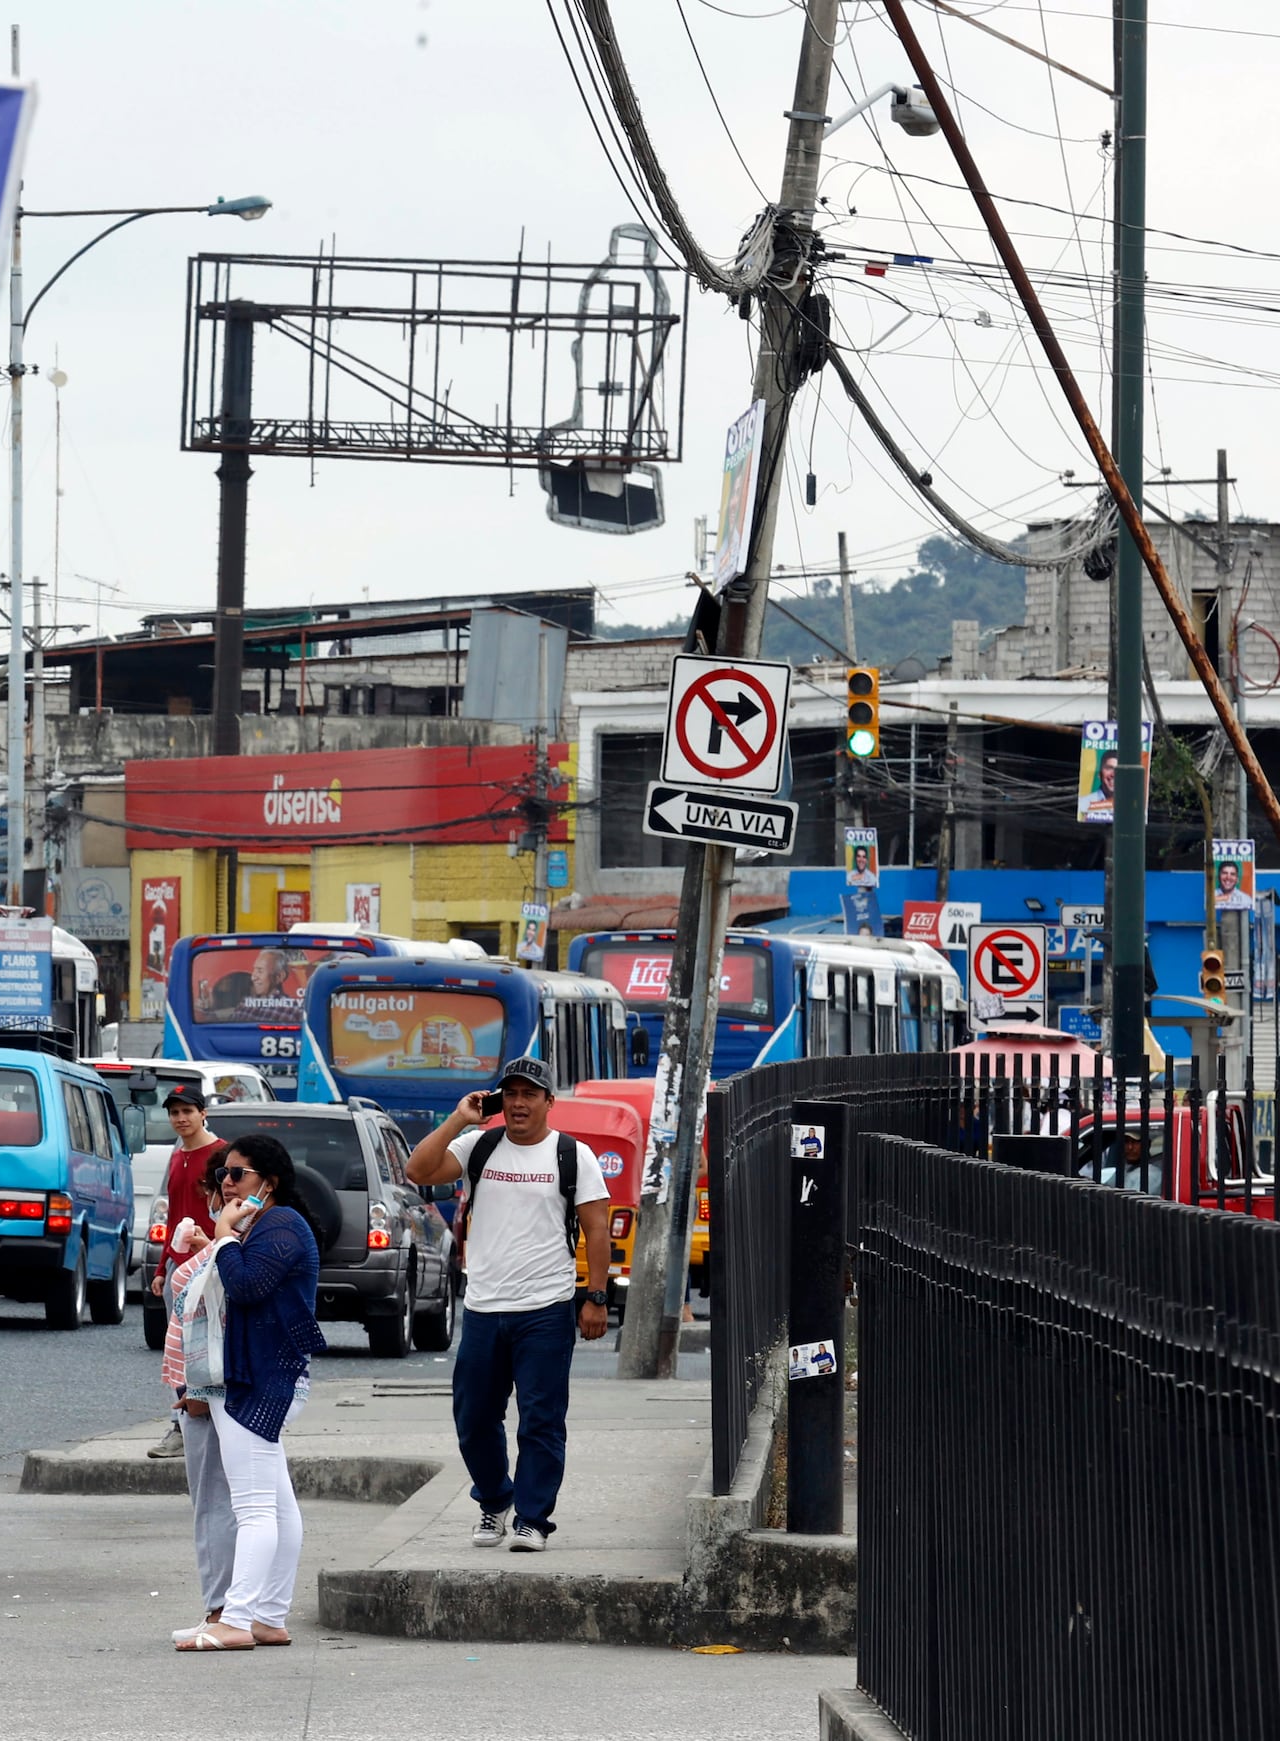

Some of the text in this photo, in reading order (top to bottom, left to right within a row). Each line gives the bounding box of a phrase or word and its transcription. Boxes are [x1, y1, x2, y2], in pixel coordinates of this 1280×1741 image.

[686, 805, 777, 836] UNA VIA
[846, 830, 875, 841] OTTO
[522, 904, 548, 917] OTTO
[947, 908, 964, 918] 500
[2, 955, 37, 968] PLANOS
[245, 997, 294, 1008] INTERNET
[330, 992, 415, 1014] Mulgatol
[260, 1036, 295, 1057] 85
[600, 1155, 620, 1172] 36
